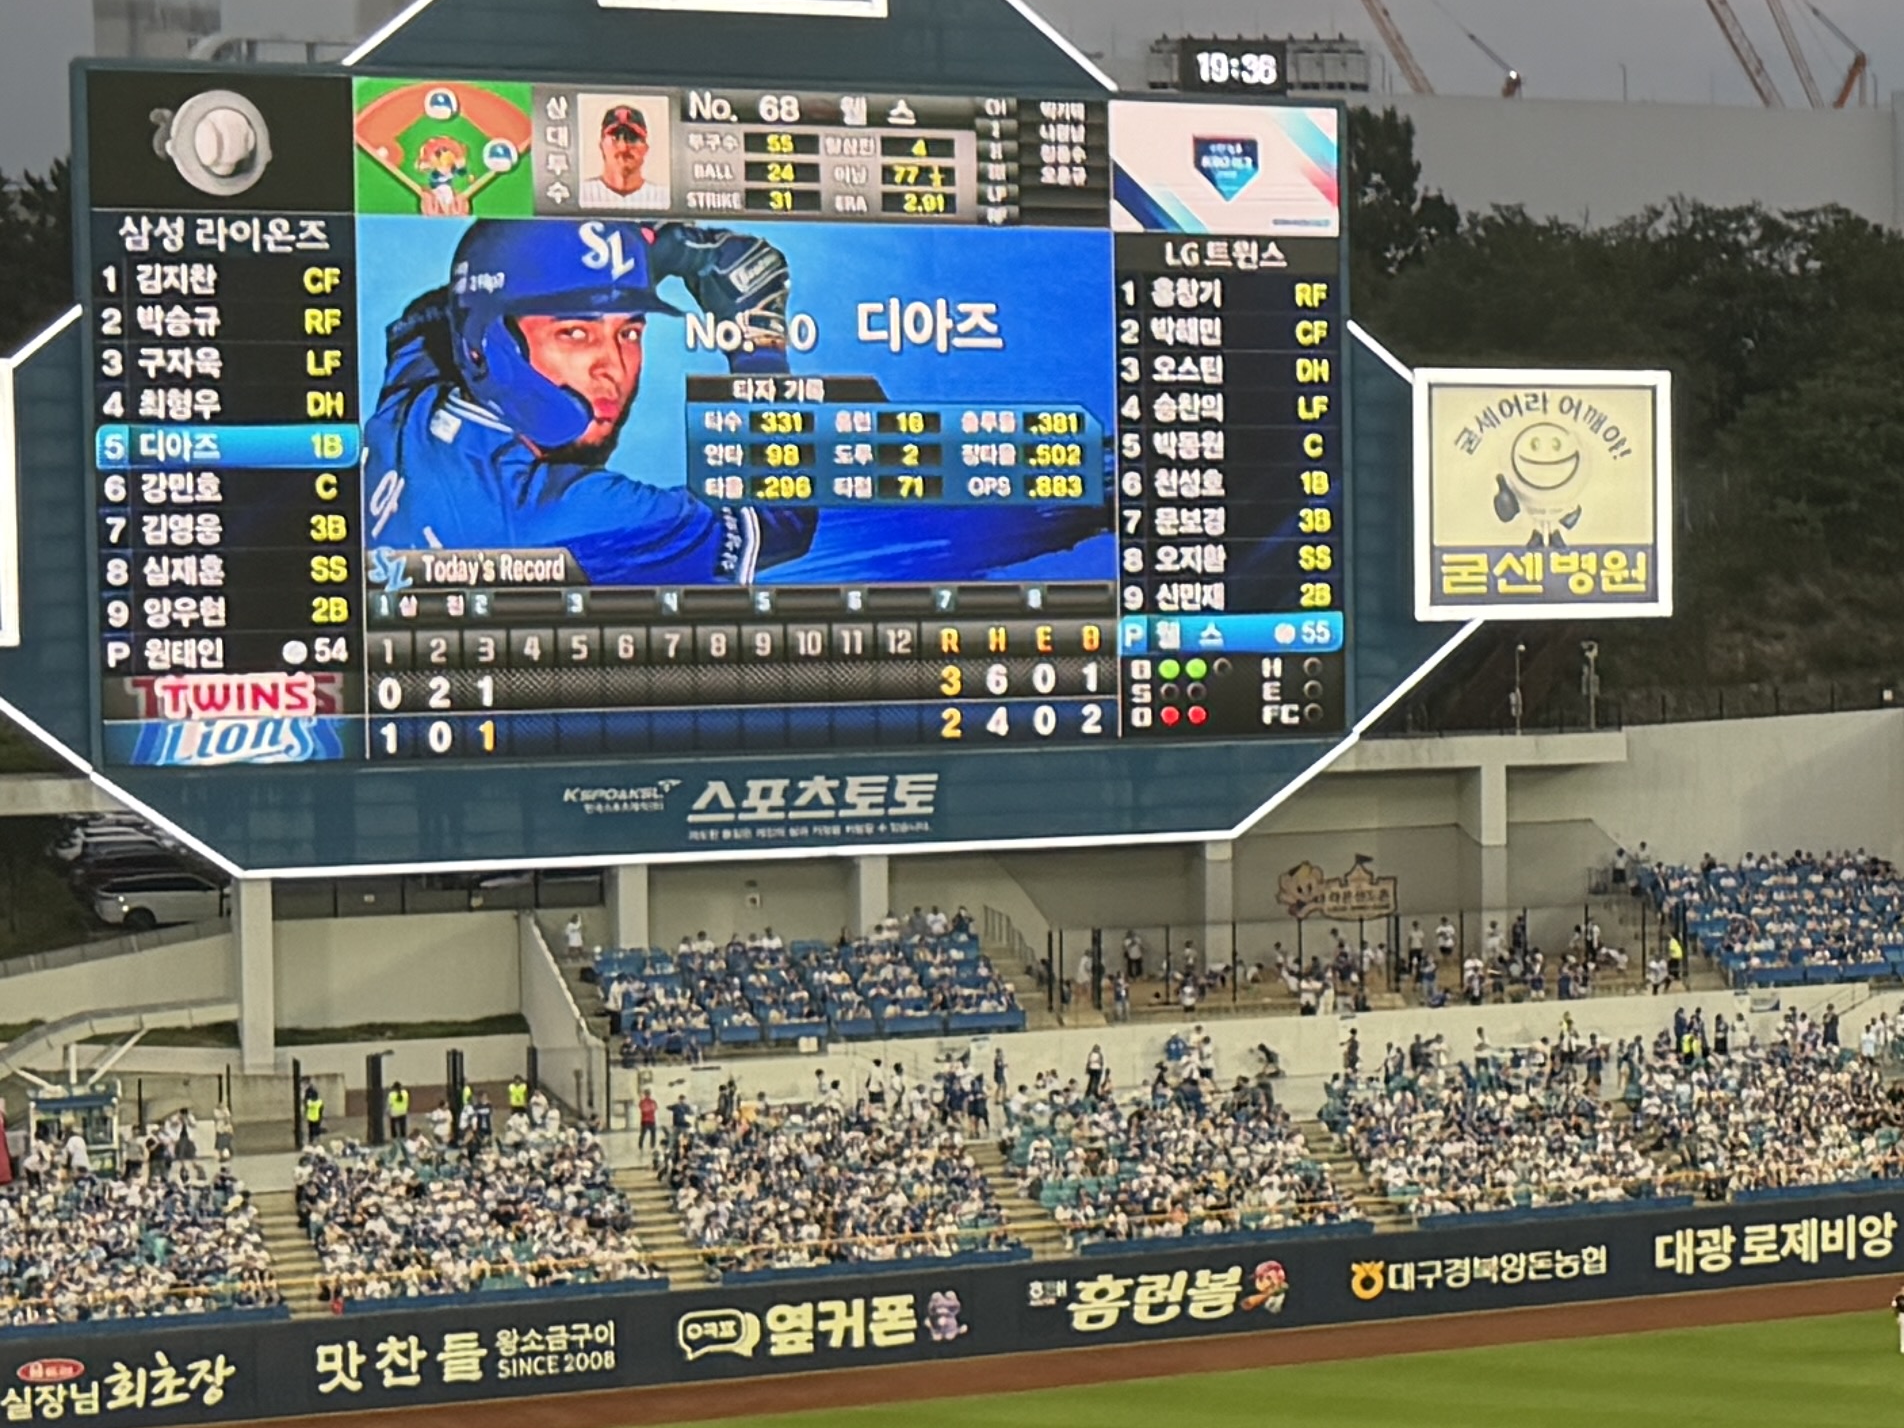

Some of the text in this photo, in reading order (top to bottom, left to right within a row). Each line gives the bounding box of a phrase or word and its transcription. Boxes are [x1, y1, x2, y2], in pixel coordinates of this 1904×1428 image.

[1197, 51, 1278, 85] 19:36
[689, 90, 800, 122] No. 68
[767, 163, 795, 182] 24
[686, 190, 793, 210] STRIKE 31
[119, 216, 330, 252] 삼성 라이온즈
[1165, 240, 1287, 270] LG 트윈스
[136, 262, 341, 295] 김지찬 CF
[1152, 276, 1328, 308] 홍창기 RF
[136, 305, 341, 337] 박승규 RF
[857, 297, 1003, 353] 디아즈
[1151, 316, 1328, 346] 박해민 CF
[138, 347, 342, 378] 구자욱 LF
[1152, 355, 1330, 384] 오스틴 DH
[138, 388, 345, 420] 최형우 DH
[732, 377, 777, 403] 타자
[761, 411, 803, 433] 331
[1298, 396, 1329, 420] LF
[140, 428, 345, 463] 디아즈 1B
[766, 443, 1081, 466] 98 .502
[1153, 430, 1323, 460] 박동원 C
[142, 472, 337, 504] 강민호 C
[898, 476, 923, 498] 71
[967, 477, 1011, 497] OPS
[1300, 470, 1330, 495] 1B
[142, 513, 347, 546] 김영웅 3B
[1155, 507, 1331, 536] 문보경 3B
[143, 554, 347, 586] 심재훈 SS
[421, 553, 565, 585] Today's Record
[1155, 544, 1332, 574] 오지환 SS
[144, 595, 348, 628] 양우현 2B
[1155, 582, 1332, 611] 신민재 2B
[664, 625, 1100, 658] 7 8 9 10 11 12 R H E B
[1124, 620, 1331, 648] P 55
[107, 637, 347, 670] P 원태인 54
[158, 682, 311, 714] TWINS
[378, 663, 1098, 710] 0 2 1 3 6 0 1
[381, 704, 1102, 754] 1 0 1 2 4 0 2
[1261, 703, 1300, 725] FC
[157, 720, 311, 764] Lions
[687, 773, 938, 823] 스포츠토토
[1655, 1211, 1898, 1275] 대광 로제비앙
[1388, 1246, 1607, 1292] 대구경북양돈농협
[1067, 1265, 1243, 1332] 홈런볼
[495, 1321, 616, 1357] 왕소금구이
[765, 1294, 918, 1356] 옆커폰
[497, 1350, 616, 1379] SINCE 2008
[0, 1381, 99, 1420] 실장님
[104, 1351, 236, 1409] 회초장
